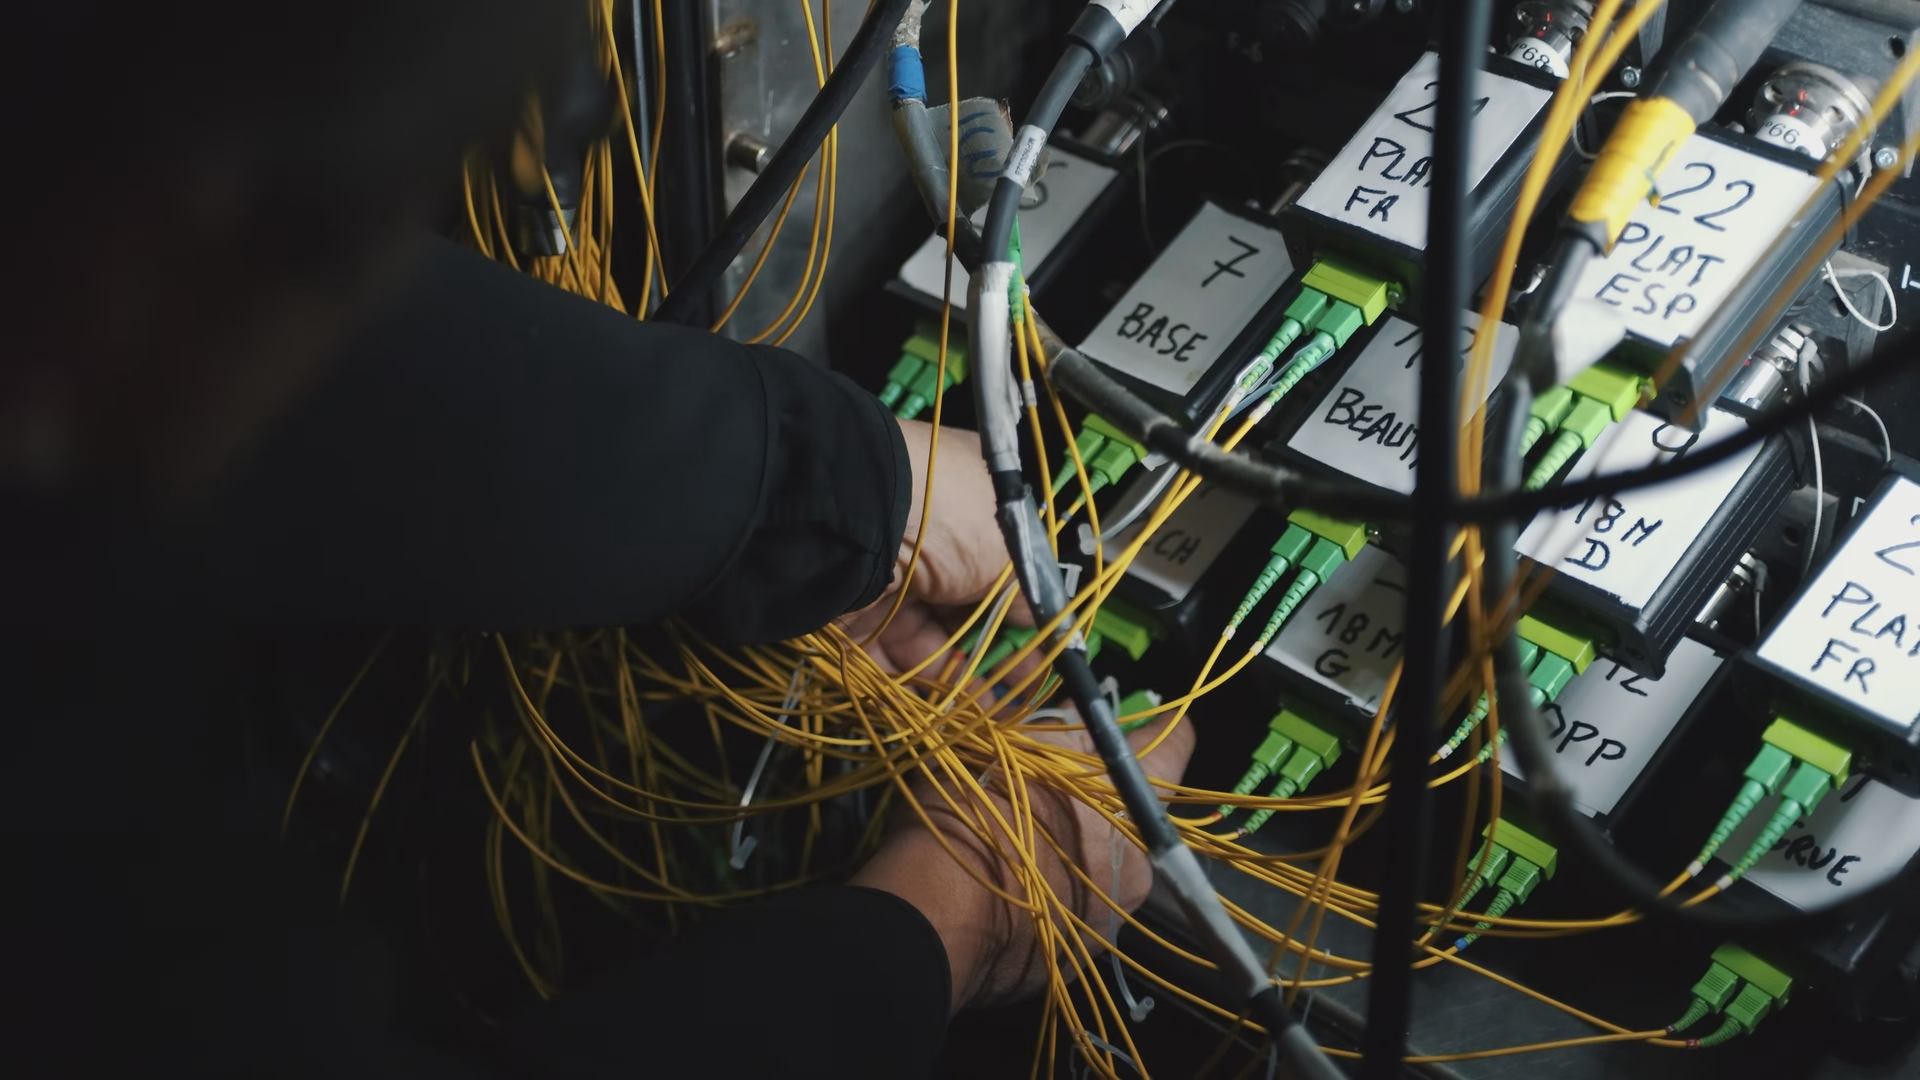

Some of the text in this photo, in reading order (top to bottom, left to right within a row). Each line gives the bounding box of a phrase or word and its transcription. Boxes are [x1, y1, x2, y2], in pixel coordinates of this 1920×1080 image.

[1357, 137, 1432, 187] PLA
[1344, 185, 1400, 222] FR
[1655, 161, 1756, 232] 22
[1201, 234, 1261, 288] 7
[1614, 221, 1726, 288] PLAT
[1594, 273, 1697, 320] ESP
[1116, 302, 1209, 362] BASE
[1323, 387, 1420, 470] BEAUT
[1564, 537, 1611, 572] D
[1314, 648, 1351, 679] G
[1811, 638, 1876, 695] FR
[1770, 818, 1861, 887] RUE
